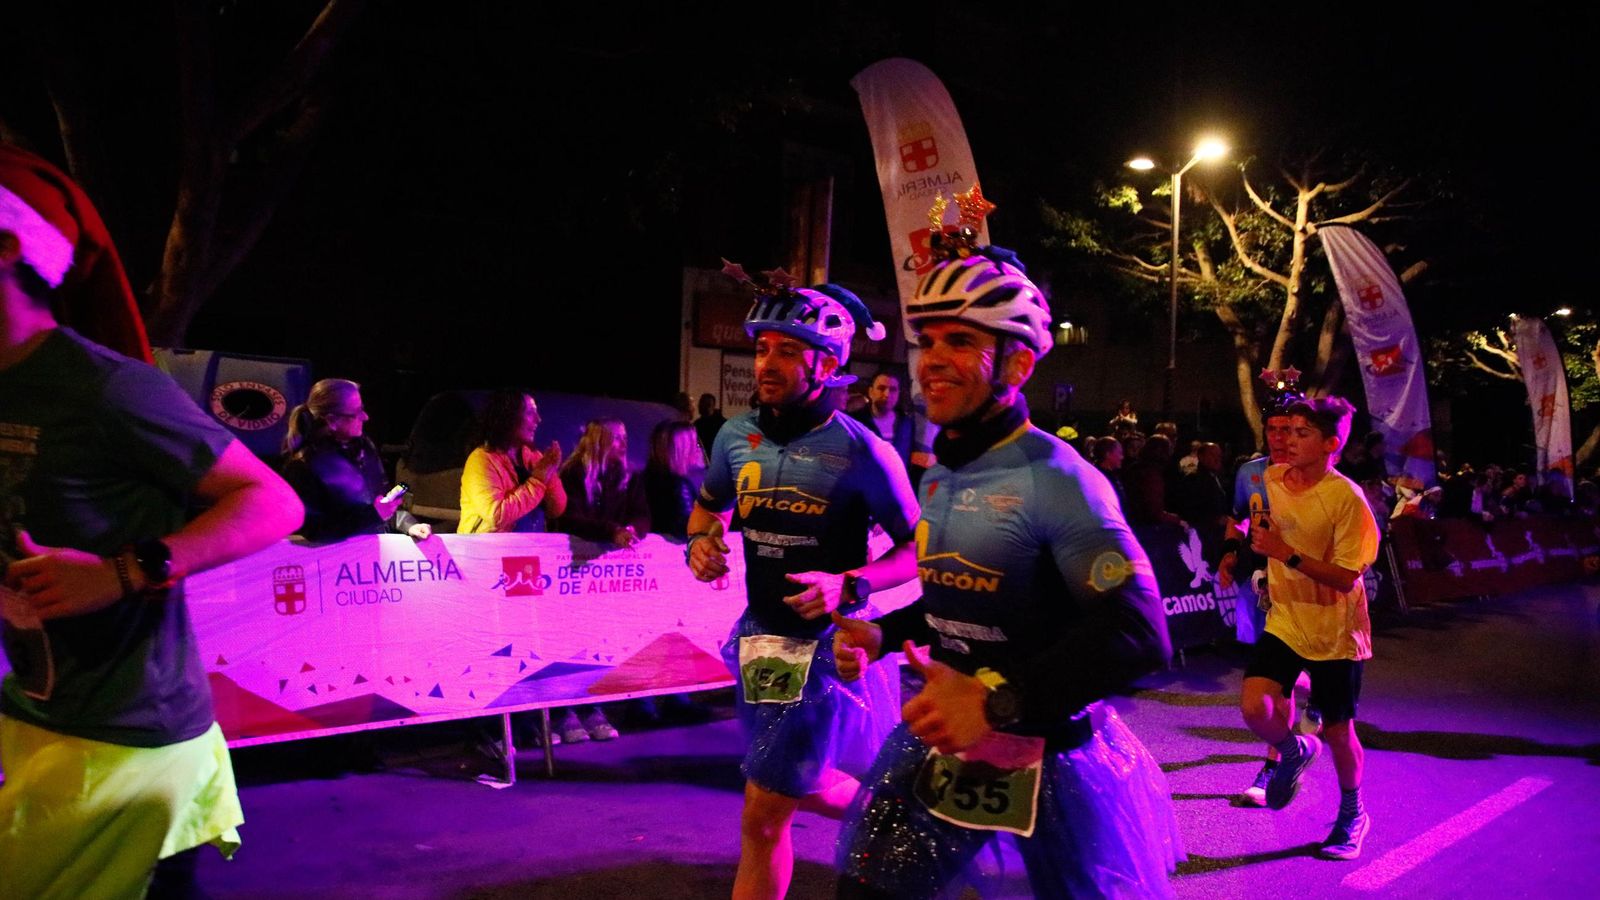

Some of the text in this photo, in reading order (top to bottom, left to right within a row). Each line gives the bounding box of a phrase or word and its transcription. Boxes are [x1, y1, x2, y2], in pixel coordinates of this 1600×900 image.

[724, 364, 756, 378] Pens
[218, 411, 281, 429] DE VIDRIO
[335, 553, 462, 586] ALMERÍA
[558, 563, 645, 579] DEPORTES
[560, 581, 581, 595] DE
[587, 578, 658, 594] ALMERIA
[335, 588, 403, 606] CIUDAD
